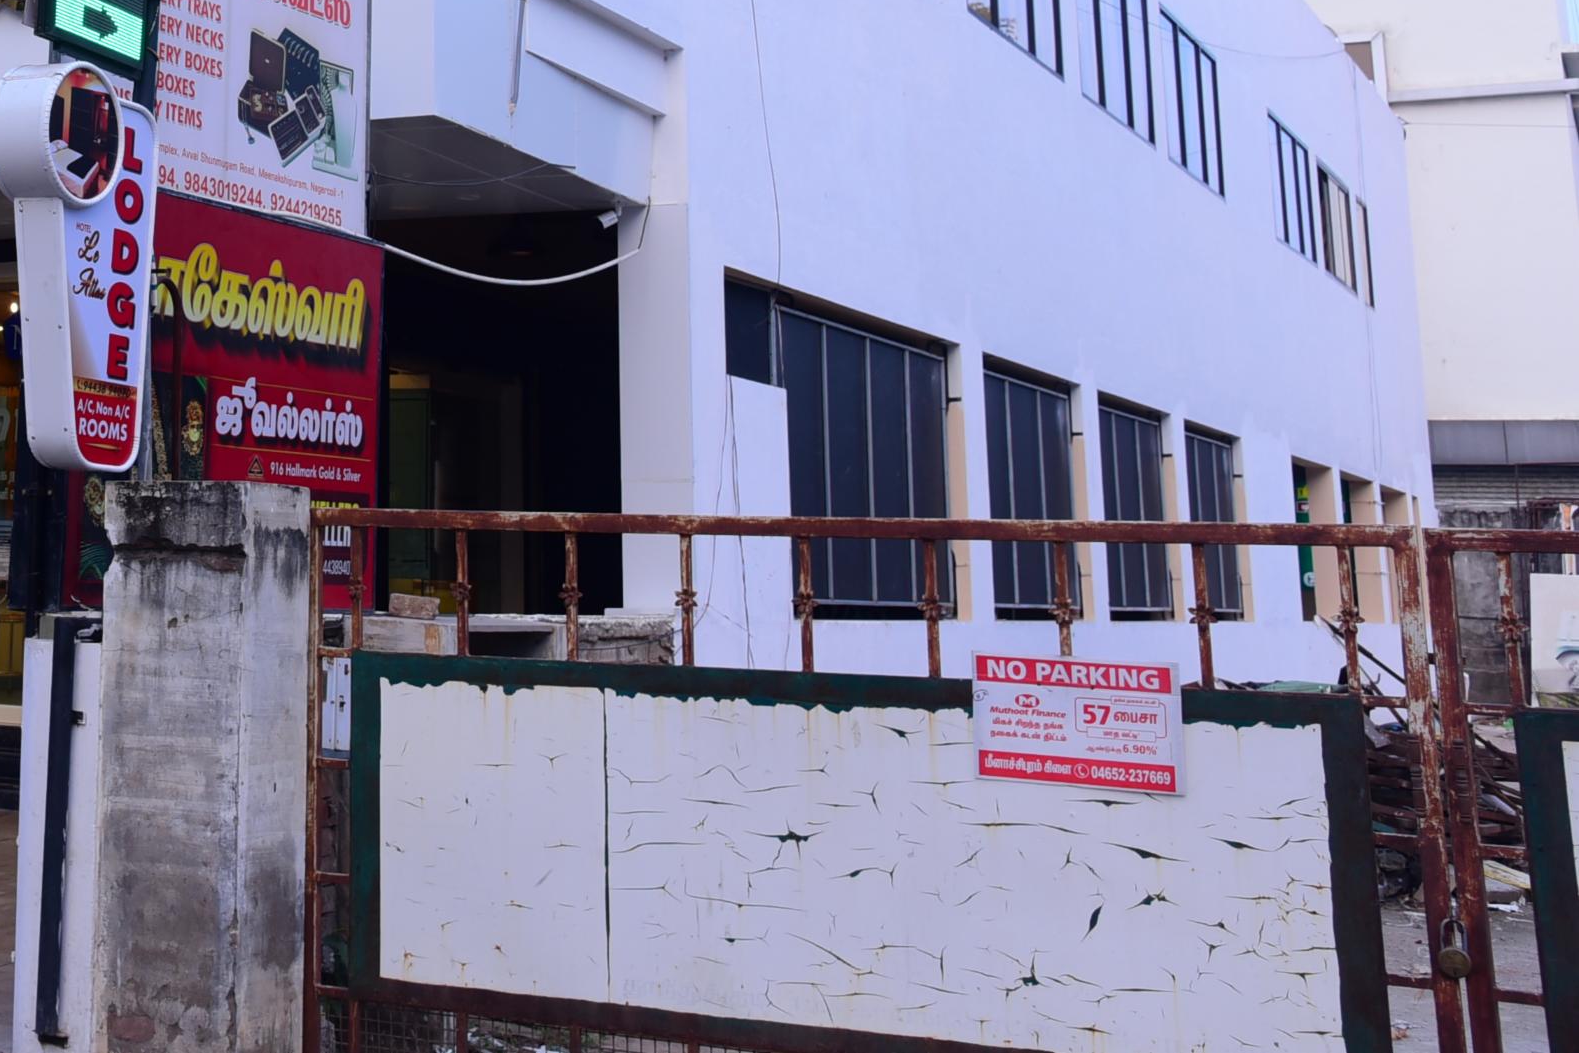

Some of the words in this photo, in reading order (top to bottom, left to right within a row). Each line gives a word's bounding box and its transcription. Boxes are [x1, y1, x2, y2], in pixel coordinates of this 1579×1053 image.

[160, 14, 182, 38] ERY
[186, 23, 224, 51] NECKS
[159, 42, 181, 65] ERY
[185, 50, 224, 78] BOXES
[157, 70, 196, 98] BOXES
[166, 103, 203, 130] ITEMS
[106, 125, 144, 381] LODGE
[96, 401, 113, 416] Non
[115, 404, 130, 421] A/C
[79, 416, 128, 442] ROOMS
[270, 461, 284, 476] 916
[285, 462, 317, 479] Hallmark
[318, 465, 335, 480] Gold
[336, 467, 342, 481] &
[343, 468, 361, 483] Silver
[986, 659, 1026, 681] NO
[1036, 662, 1160, 690] PARKING
[989, 705, 1030, 716] Muthoot
[1031, 709, 1067, 718] Finance
[1083, 704, 1111, 725] 57
[1113, 711, 1158, 725] பைசா
[1091, 765, 1171, 785] 04652-237669
